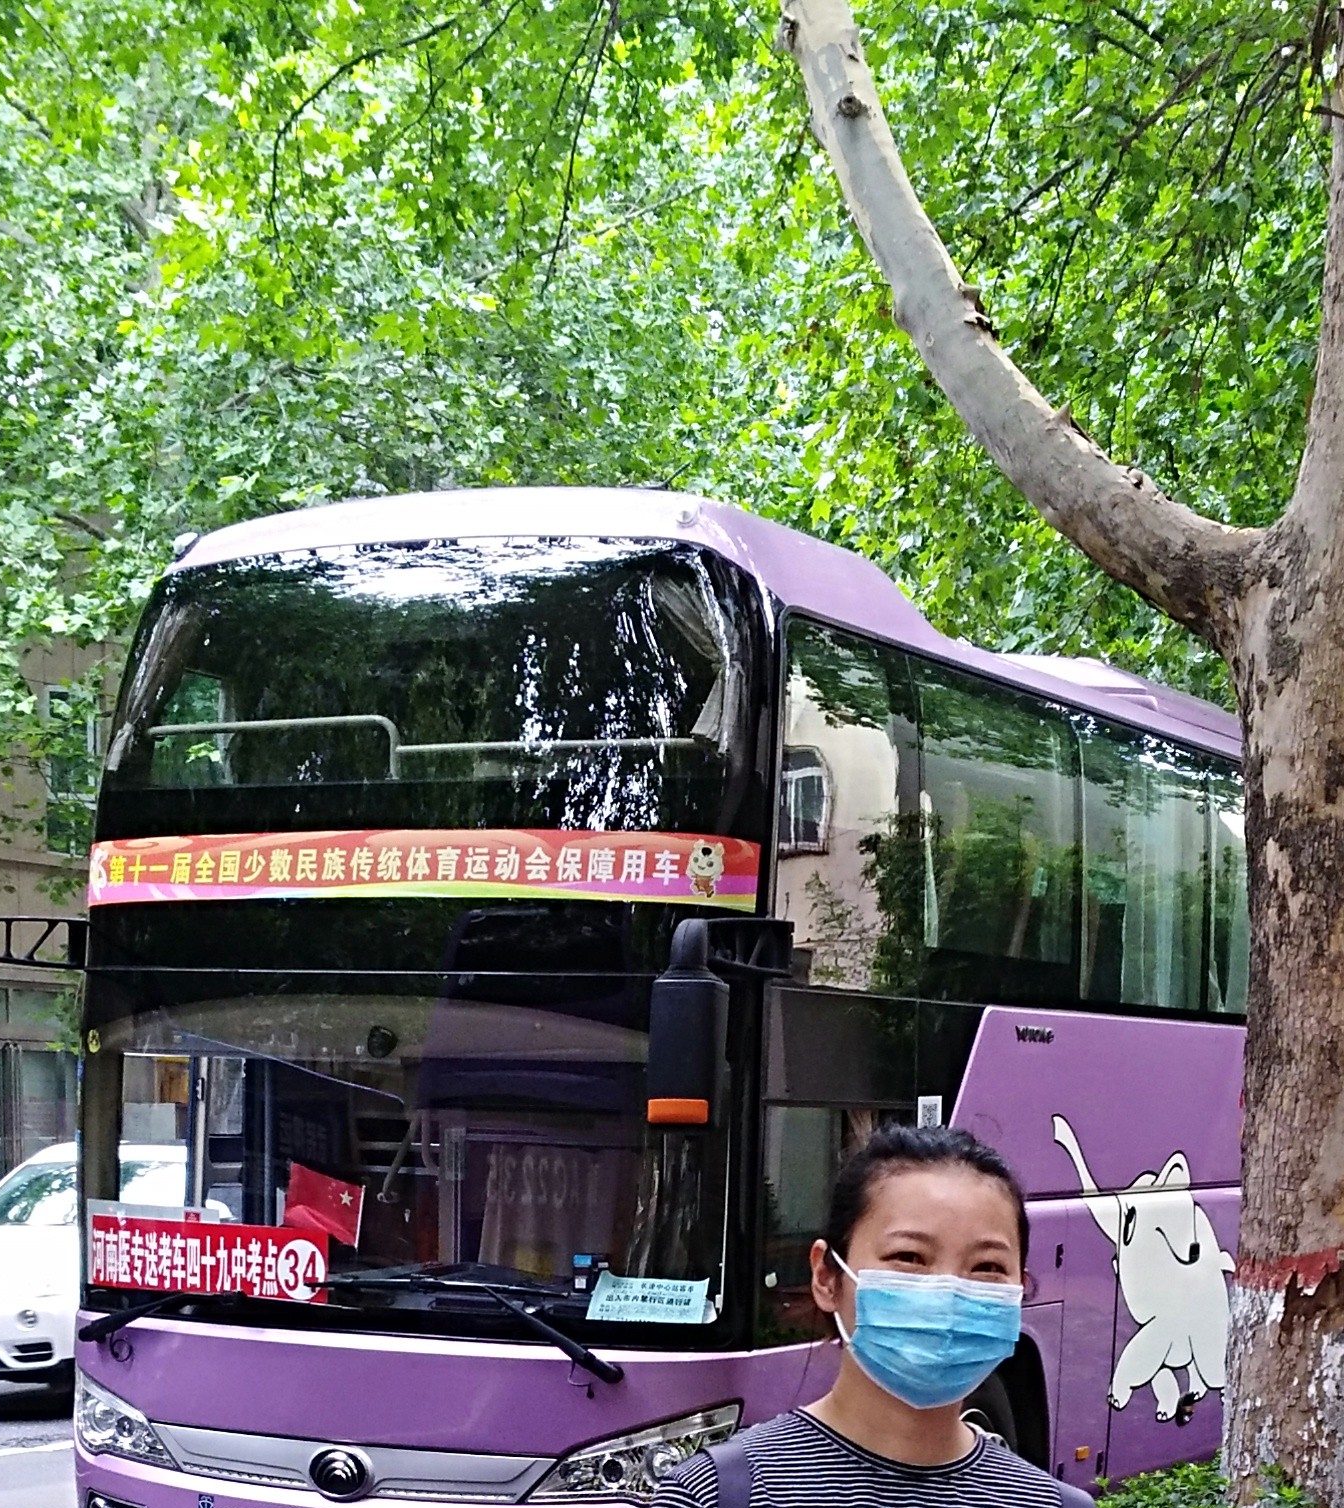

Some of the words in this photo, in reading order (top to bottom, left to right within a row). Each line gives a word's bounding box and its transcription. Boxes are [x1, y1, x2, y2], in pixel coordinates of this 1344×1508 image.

[108, 845, 680, 887] 第十一届全国少数民族传统体育运动会保障用车
[93, 1226, 279, 1296] 河南医专送考车四十九中考点
[283, 1248, 321, 1294] 34
